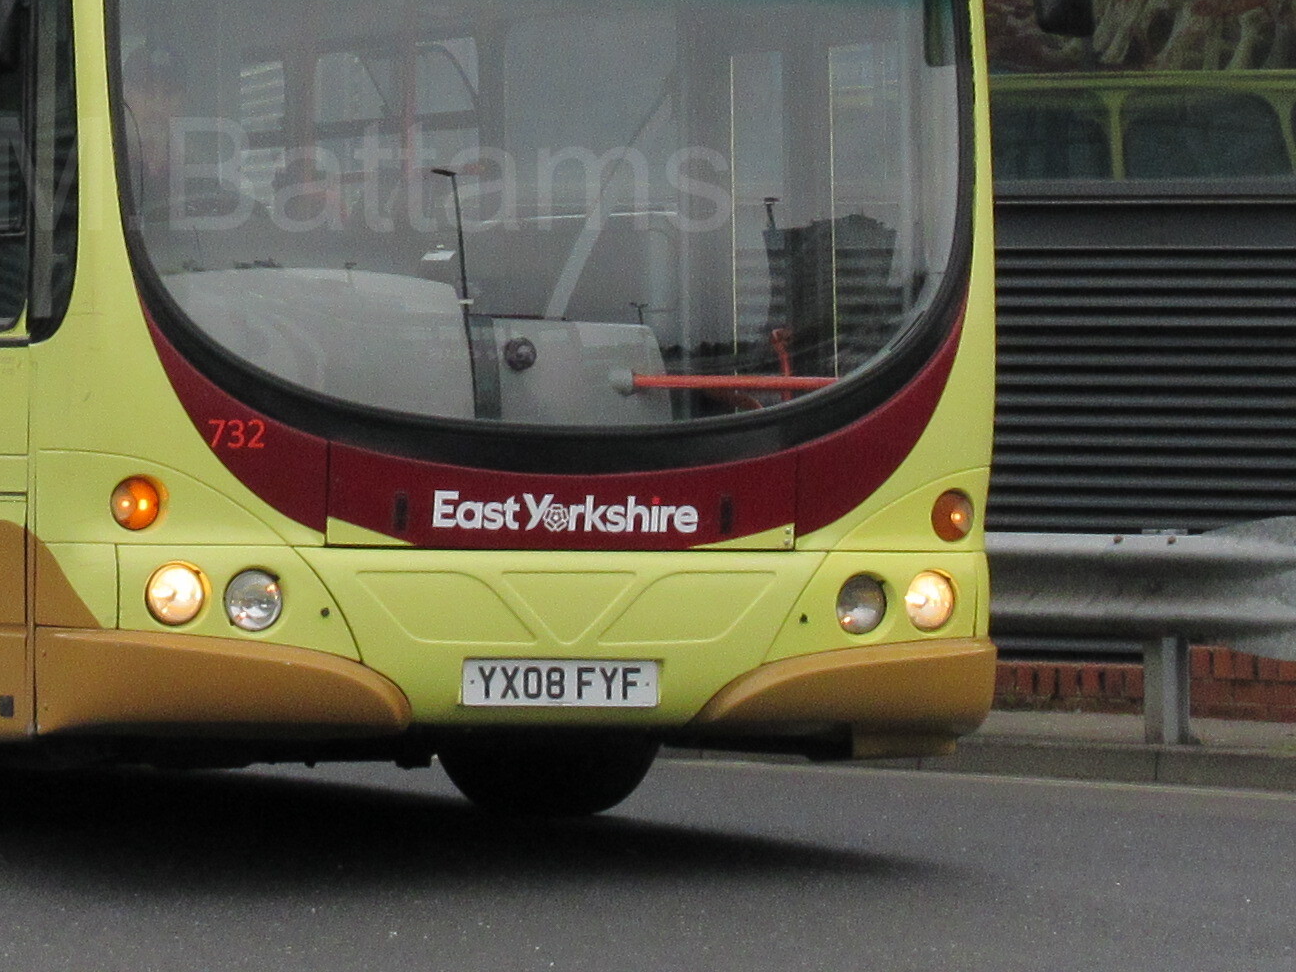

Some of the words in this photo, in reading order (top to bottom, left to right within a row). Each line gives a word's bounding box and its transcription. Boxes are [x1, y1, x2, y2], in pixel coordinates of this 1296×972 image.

[207, 419, 266, 449] 732
[477, 665, 566, 701] YX08
[576, 666, 642, 701] FYF
